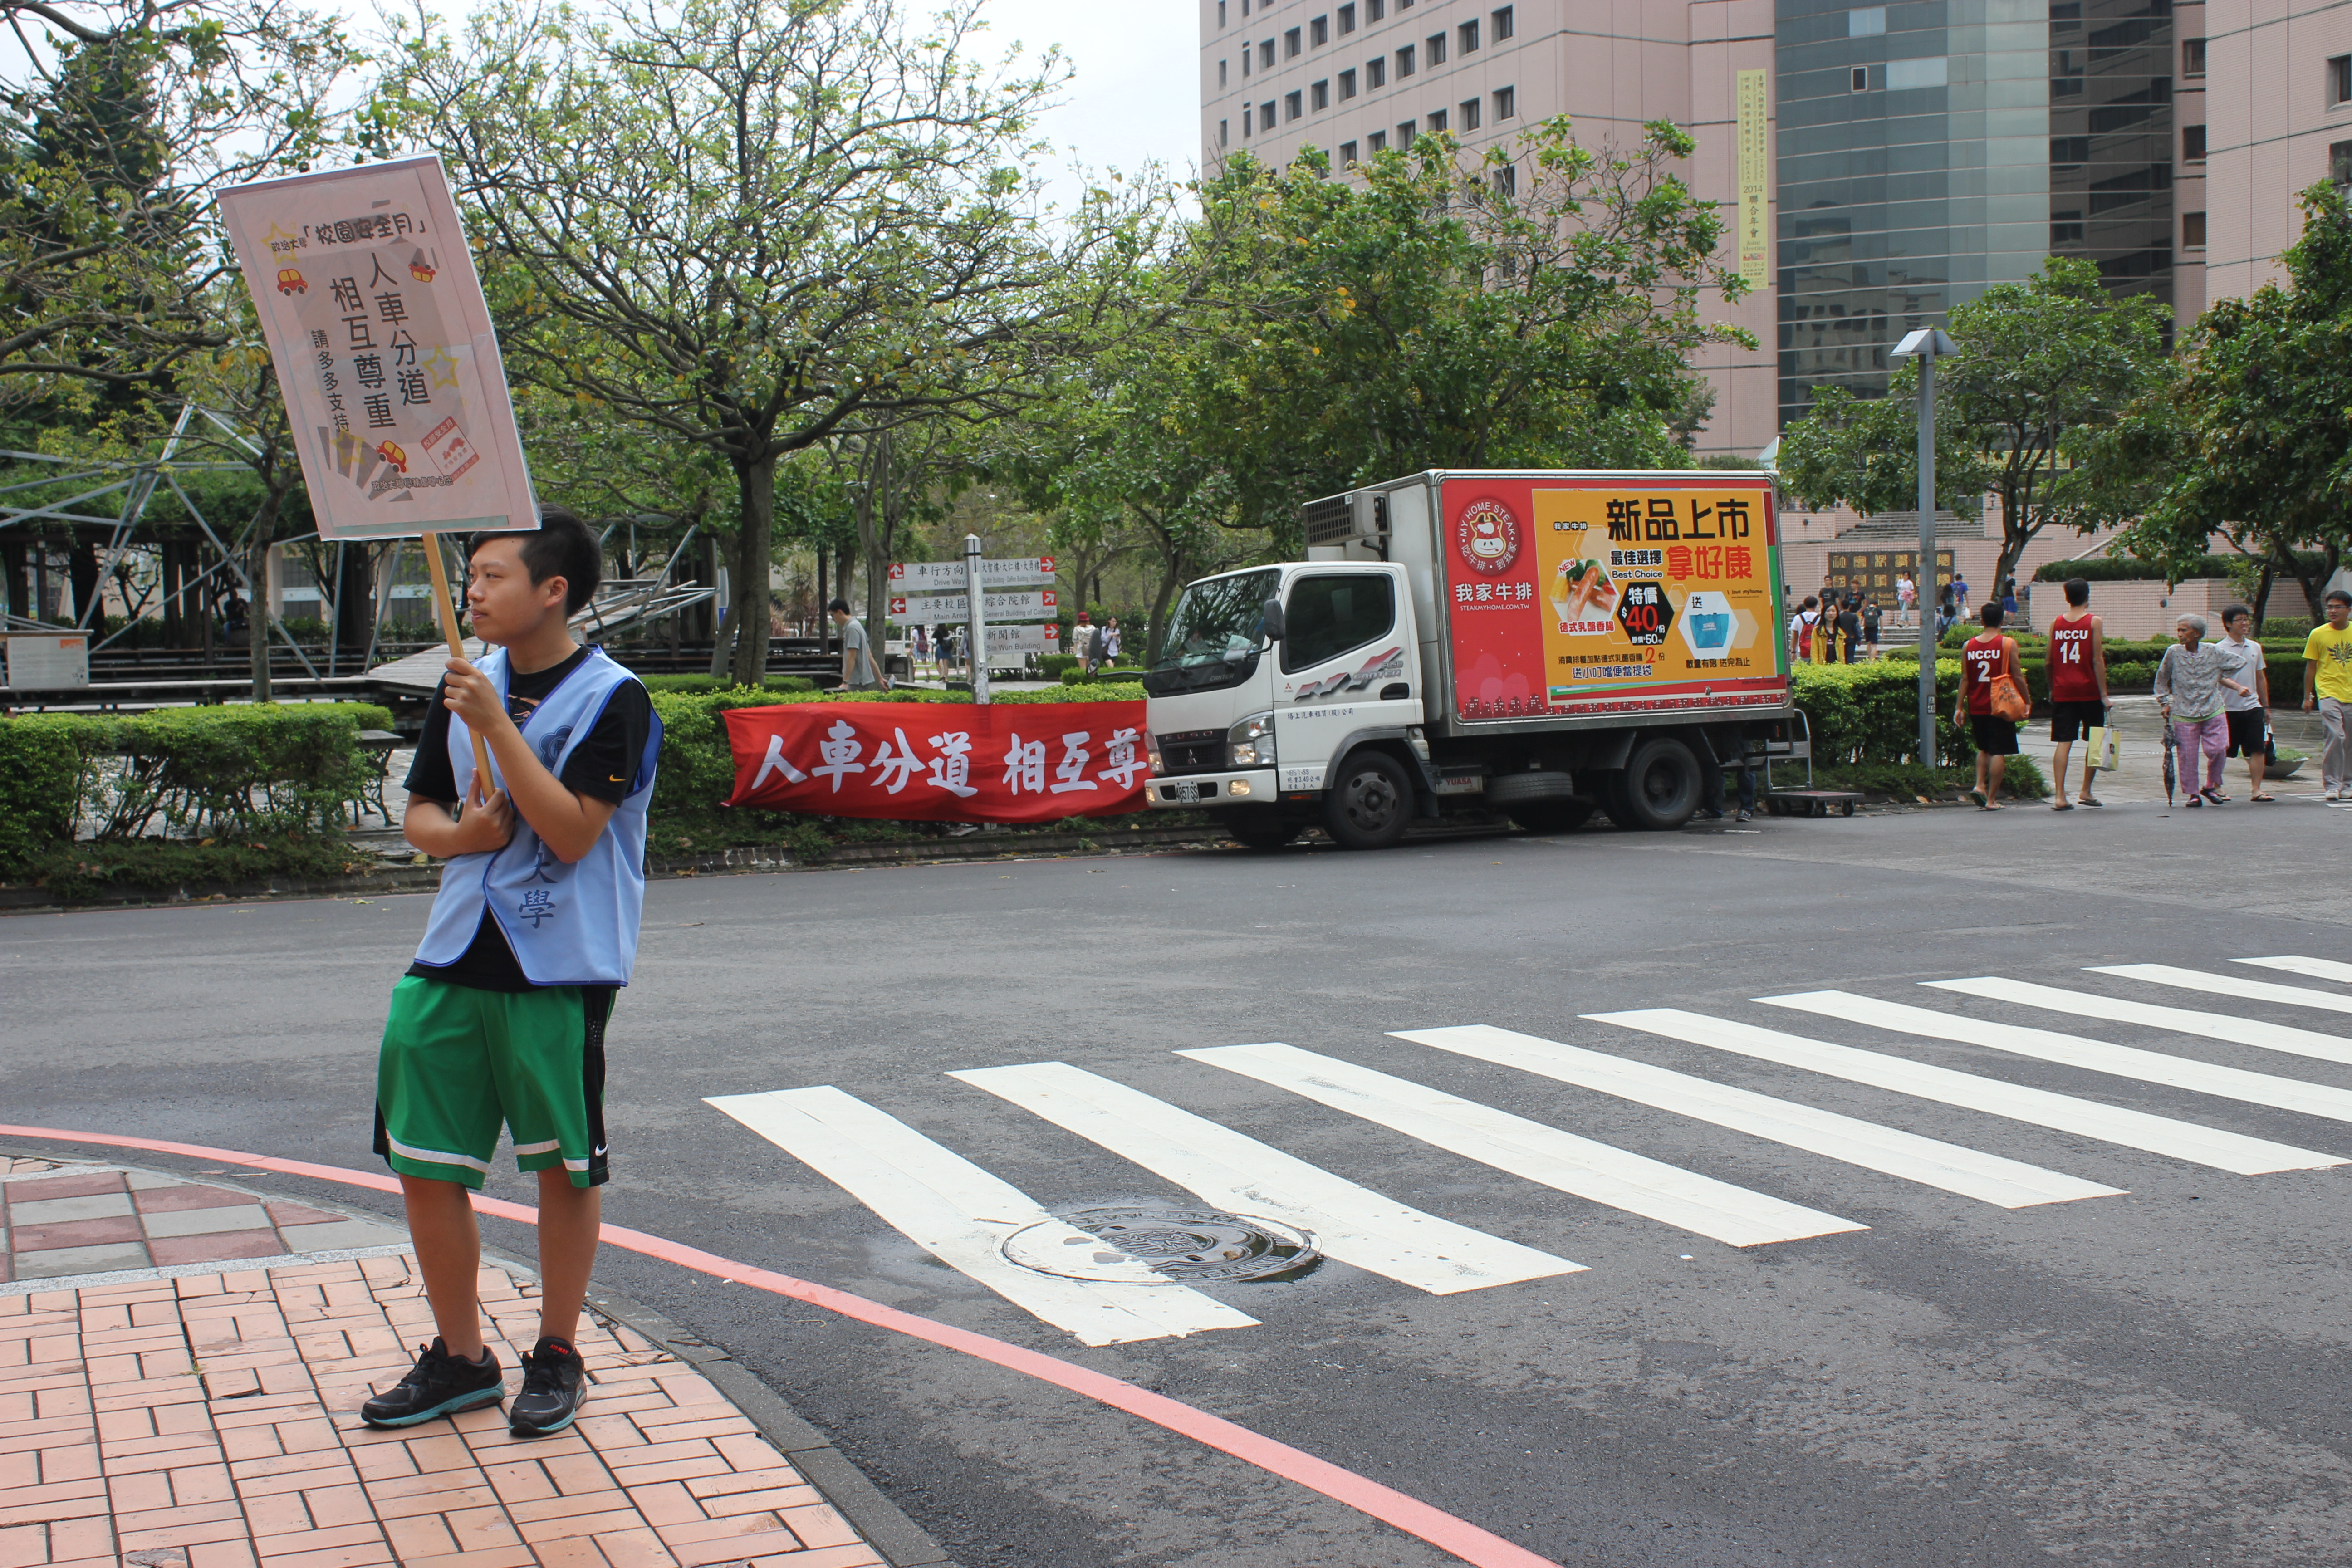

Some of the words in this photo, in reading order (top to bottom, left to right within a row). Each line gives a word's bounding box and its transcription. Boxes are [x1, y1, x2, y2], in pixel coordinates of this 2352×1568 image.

[1744, 185, 1763, 193] 2014
[1749, 195, 1759, 238] 聯合年會
[303, 213, 426, 245] 「校園安全月」
[270, 237, 308, 252] 政治大學
[369, 252, 431, 406] 人車分道
[329, 276, 397, 428] 相互尊重
[311, 329, 349, 433] 請多多支持
[1460, 520, 1468, 537] MY
[1465, 502, 1491, 520] HOME
[1494, 505, 1515, 536] STEAK
[1553, 522, 1588, 530] 我家牛排
[1606, 499, 1749, 541] 新品上市
[1611, 550, 1662, 565] 最佳選擇
[1666, 545, 1753, 581] 拿好康
[918, 565, 963, 577] 車行方向
[1558, 559, 1575, 573] NEW
[1455, 582, 1532, 602] 我家牛排
[1628, 587, 1657, 605] 特價
[922, 598, 966, 610] 主要校區
[985, 595, 1030, 607] 綜合院館
[1692, 596, 1702, 608] 送
[1559, 621, 1614, 632] 德式乳酪香腸
[986, 629, 1020, 641] 新聞館
[2055, 630, 2088, 640] NCCU
[1646, 647, 1656, 663] 2
[1968, 650, 2000, 660] NCCU
[2060, 642, 2080, 663] 14
[1720, 657, 1750, 667] 送完為止
[1353, 669, 1401, 681] CANTER
[1573, 665, 1652, 679] 送小叮噹便當提袋
[1977, 661, 1990, 682] 2
[1166, 731, 1212, 740] FUSO
[751, 720, 978, 798] 人車分道
[1003, 727, 1147, 796] 相互尊
[1446, 778, 1472, 786] YUASA
[518, 852, 558, 929] 大學
